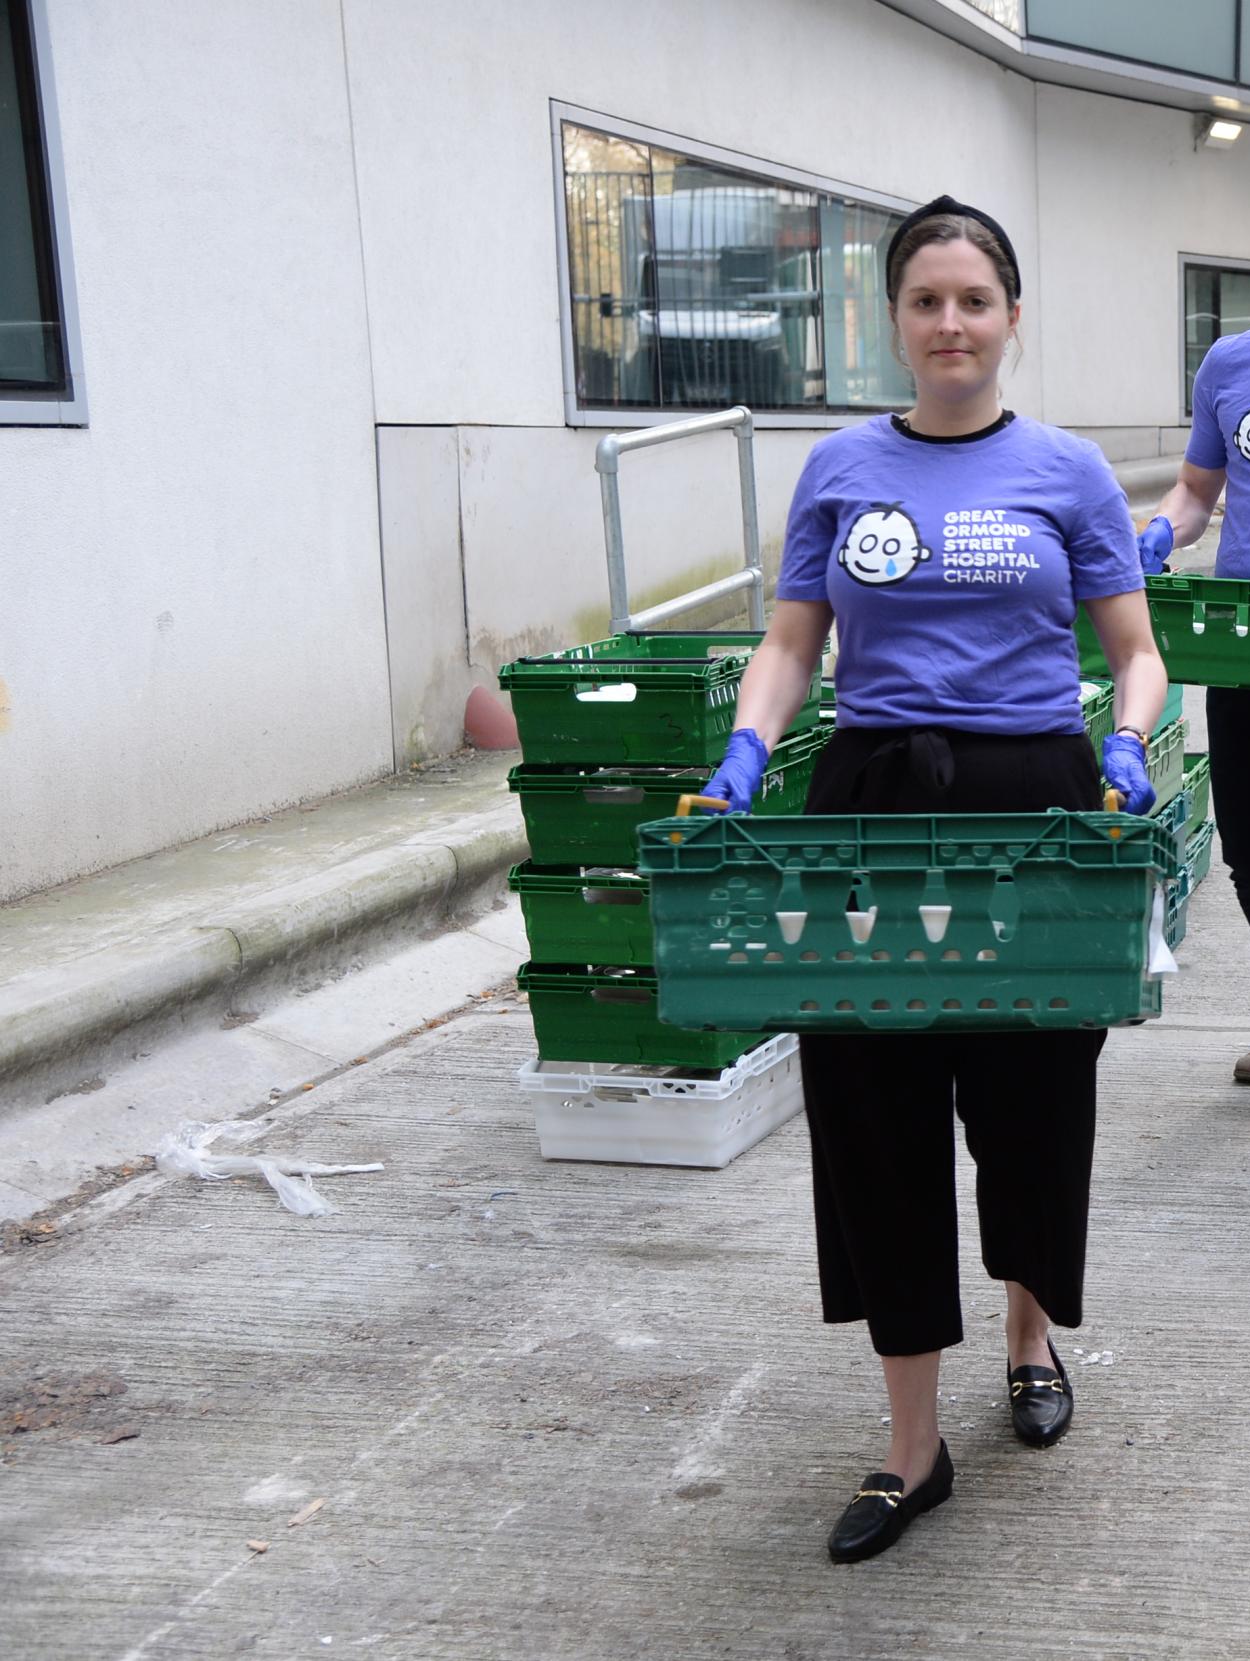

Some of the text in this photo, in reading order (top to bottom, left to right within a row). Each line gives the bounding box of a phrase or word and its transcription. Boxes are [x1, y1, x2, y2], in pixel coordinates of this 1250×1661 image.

[944, 510, 1006, 523] GREAT
[943, 524, 1031, 537] ORMOND
[944, 537, 1016, 551] STREET
[943, 553, 1040, 568] HOSPITAL
[943, 569, 1027, 584] CHARITY
